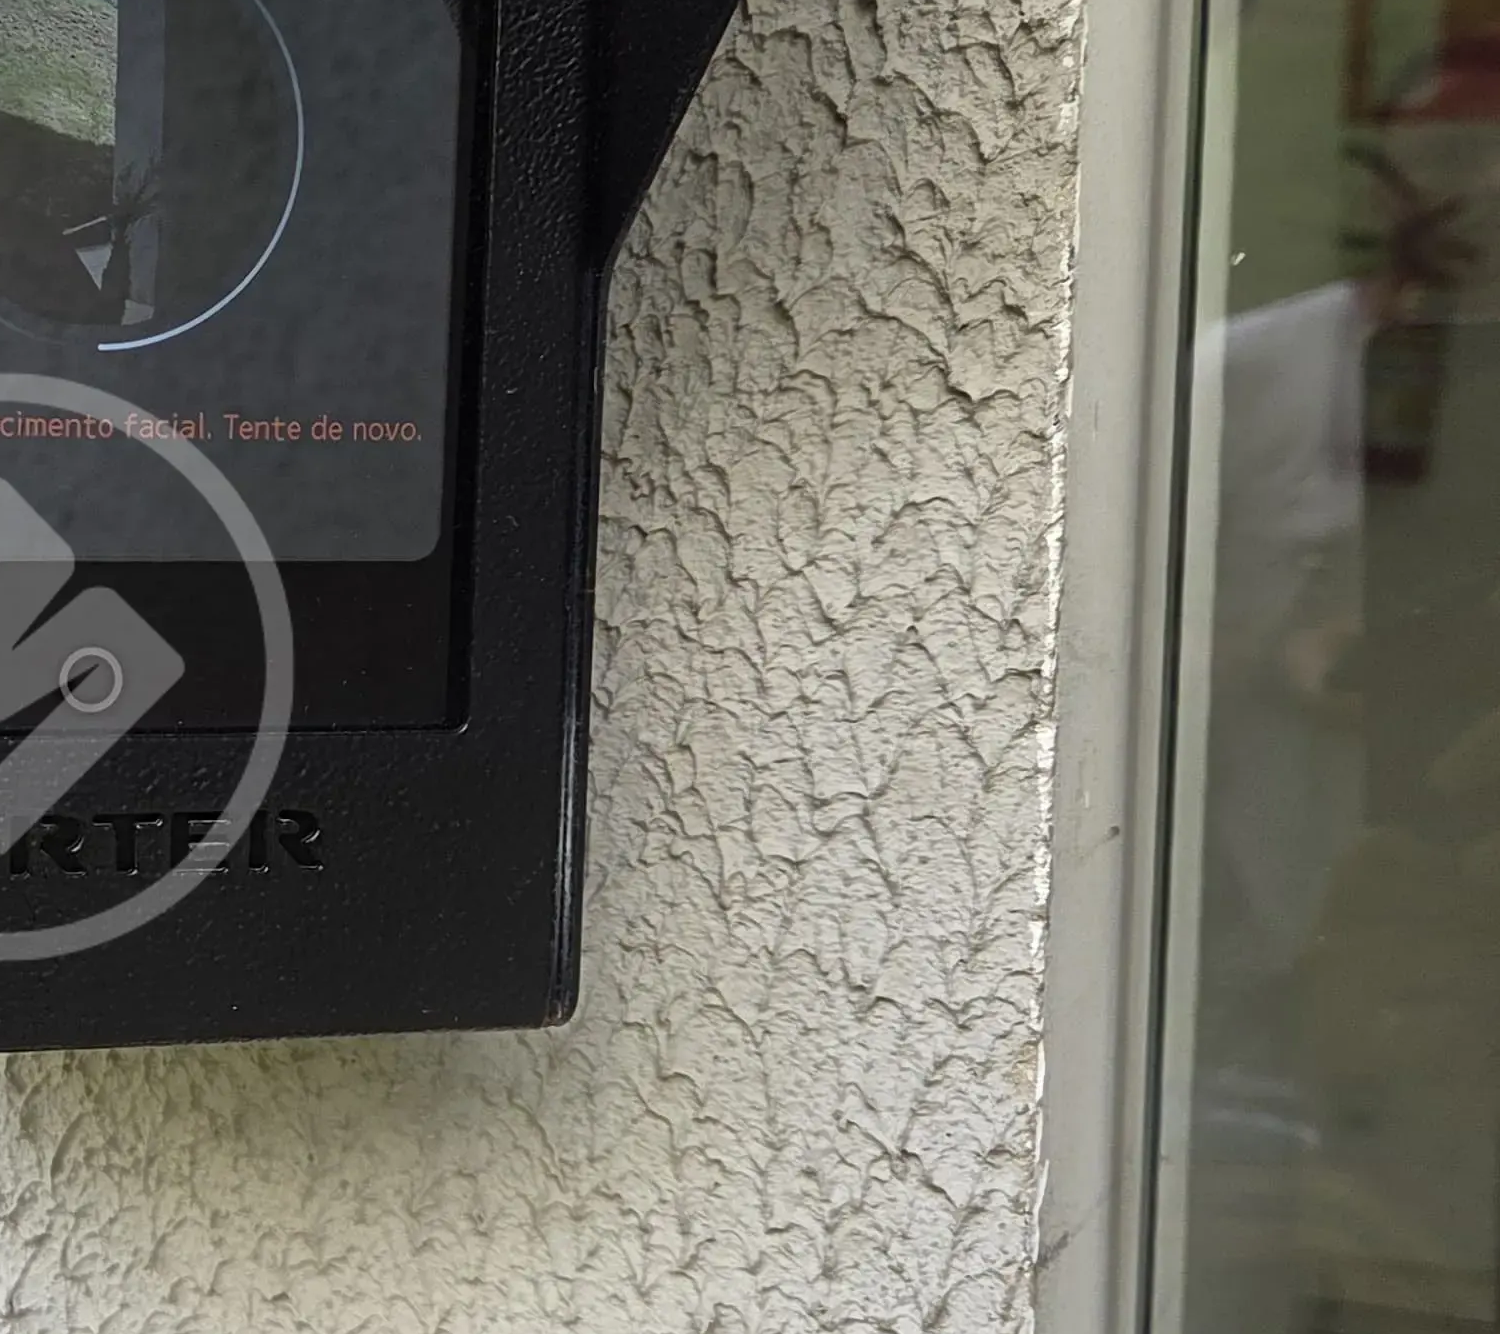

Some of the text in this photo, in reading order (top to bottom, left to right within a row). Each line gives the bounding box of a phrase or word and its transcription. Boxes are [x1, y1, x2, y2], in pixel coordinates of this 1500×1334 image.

[124, 411, 212, 441] facial.
[224, 413, 301, 442] Tente
[311, 414, 343, 442] de
[353, 419, 423, 442] novo.
